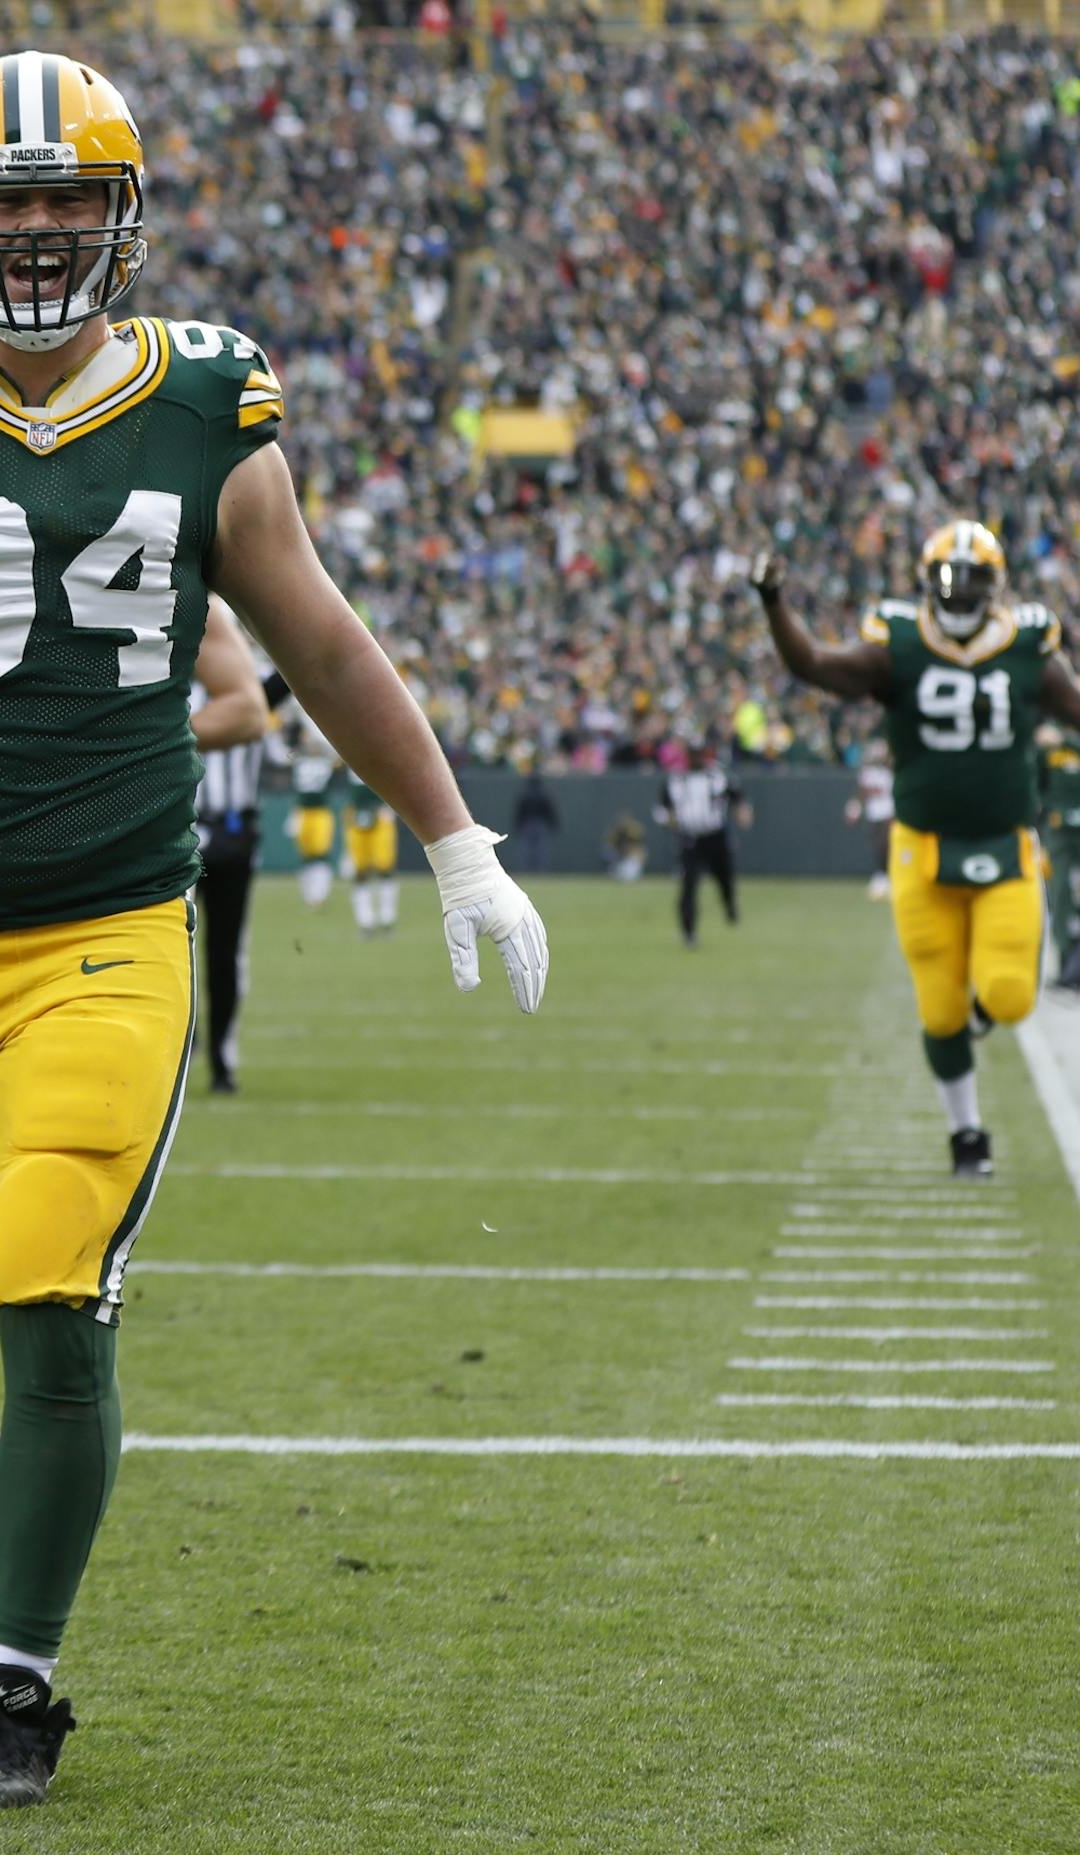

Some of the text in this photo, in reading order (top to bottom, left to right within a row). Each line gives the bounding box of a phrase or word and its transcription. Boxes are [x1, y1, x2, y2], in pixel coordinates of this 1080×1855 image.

[11, 148, 57, 162] PACKERS
[31, 431, 53, 446] NFL
[917, 664, 1015, 751] 91
[3, 1685, 37, 1707] FORCE
